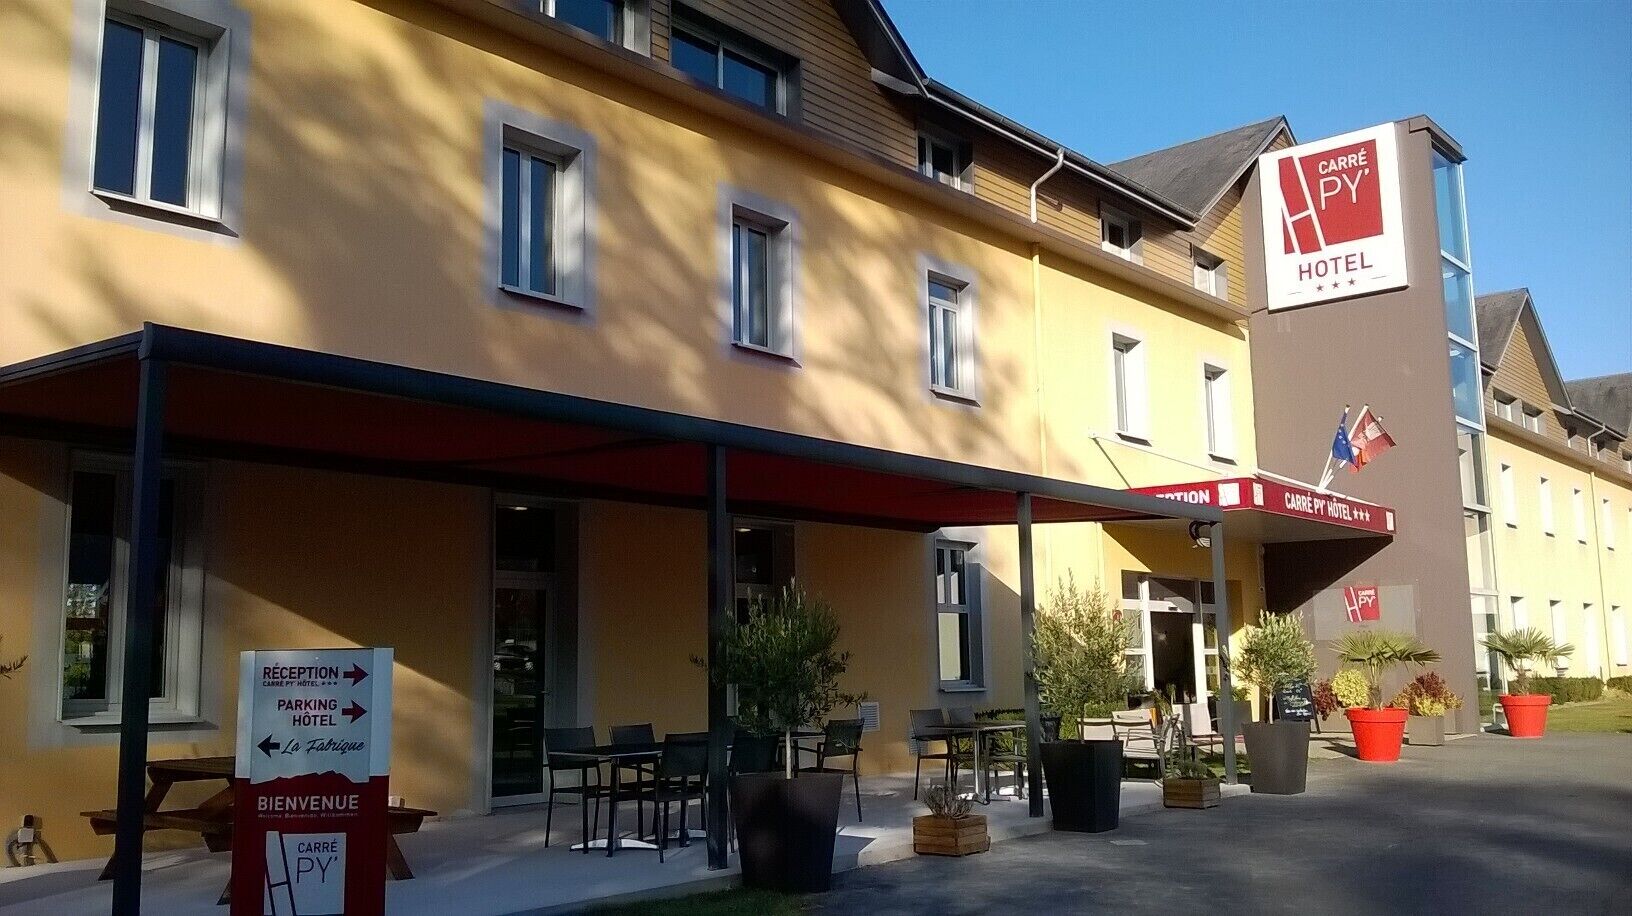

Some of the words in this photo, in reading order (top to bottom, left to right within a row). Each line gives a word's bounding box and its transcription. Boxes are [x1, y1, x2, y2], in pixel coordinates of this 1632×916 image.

[1318, 147, 1368, 175] CARRÉ
[1319, 168, 1370, 210] PY'
[1298, 252, 1373, 281] HOTEL
[1284, 491, 1313, 513] CARRÉ
[1327, 497, 1353, 521] HÔTEL
[262, 662, 339, 680] RÉCEPTION
[297, 679, 320, 687] HÔTEL
[277, 699, 338, 711] PARKING
[292, 711, 337, 727] HÔTEL
[281, 738, 300, 755] La
[305, 738, 366, 755] Fabrique
[257, 794, 359, 811] BIENVENUE
[297, 838, 338, 854] CARRÉ
[296, 856, 338, 884] PY'
